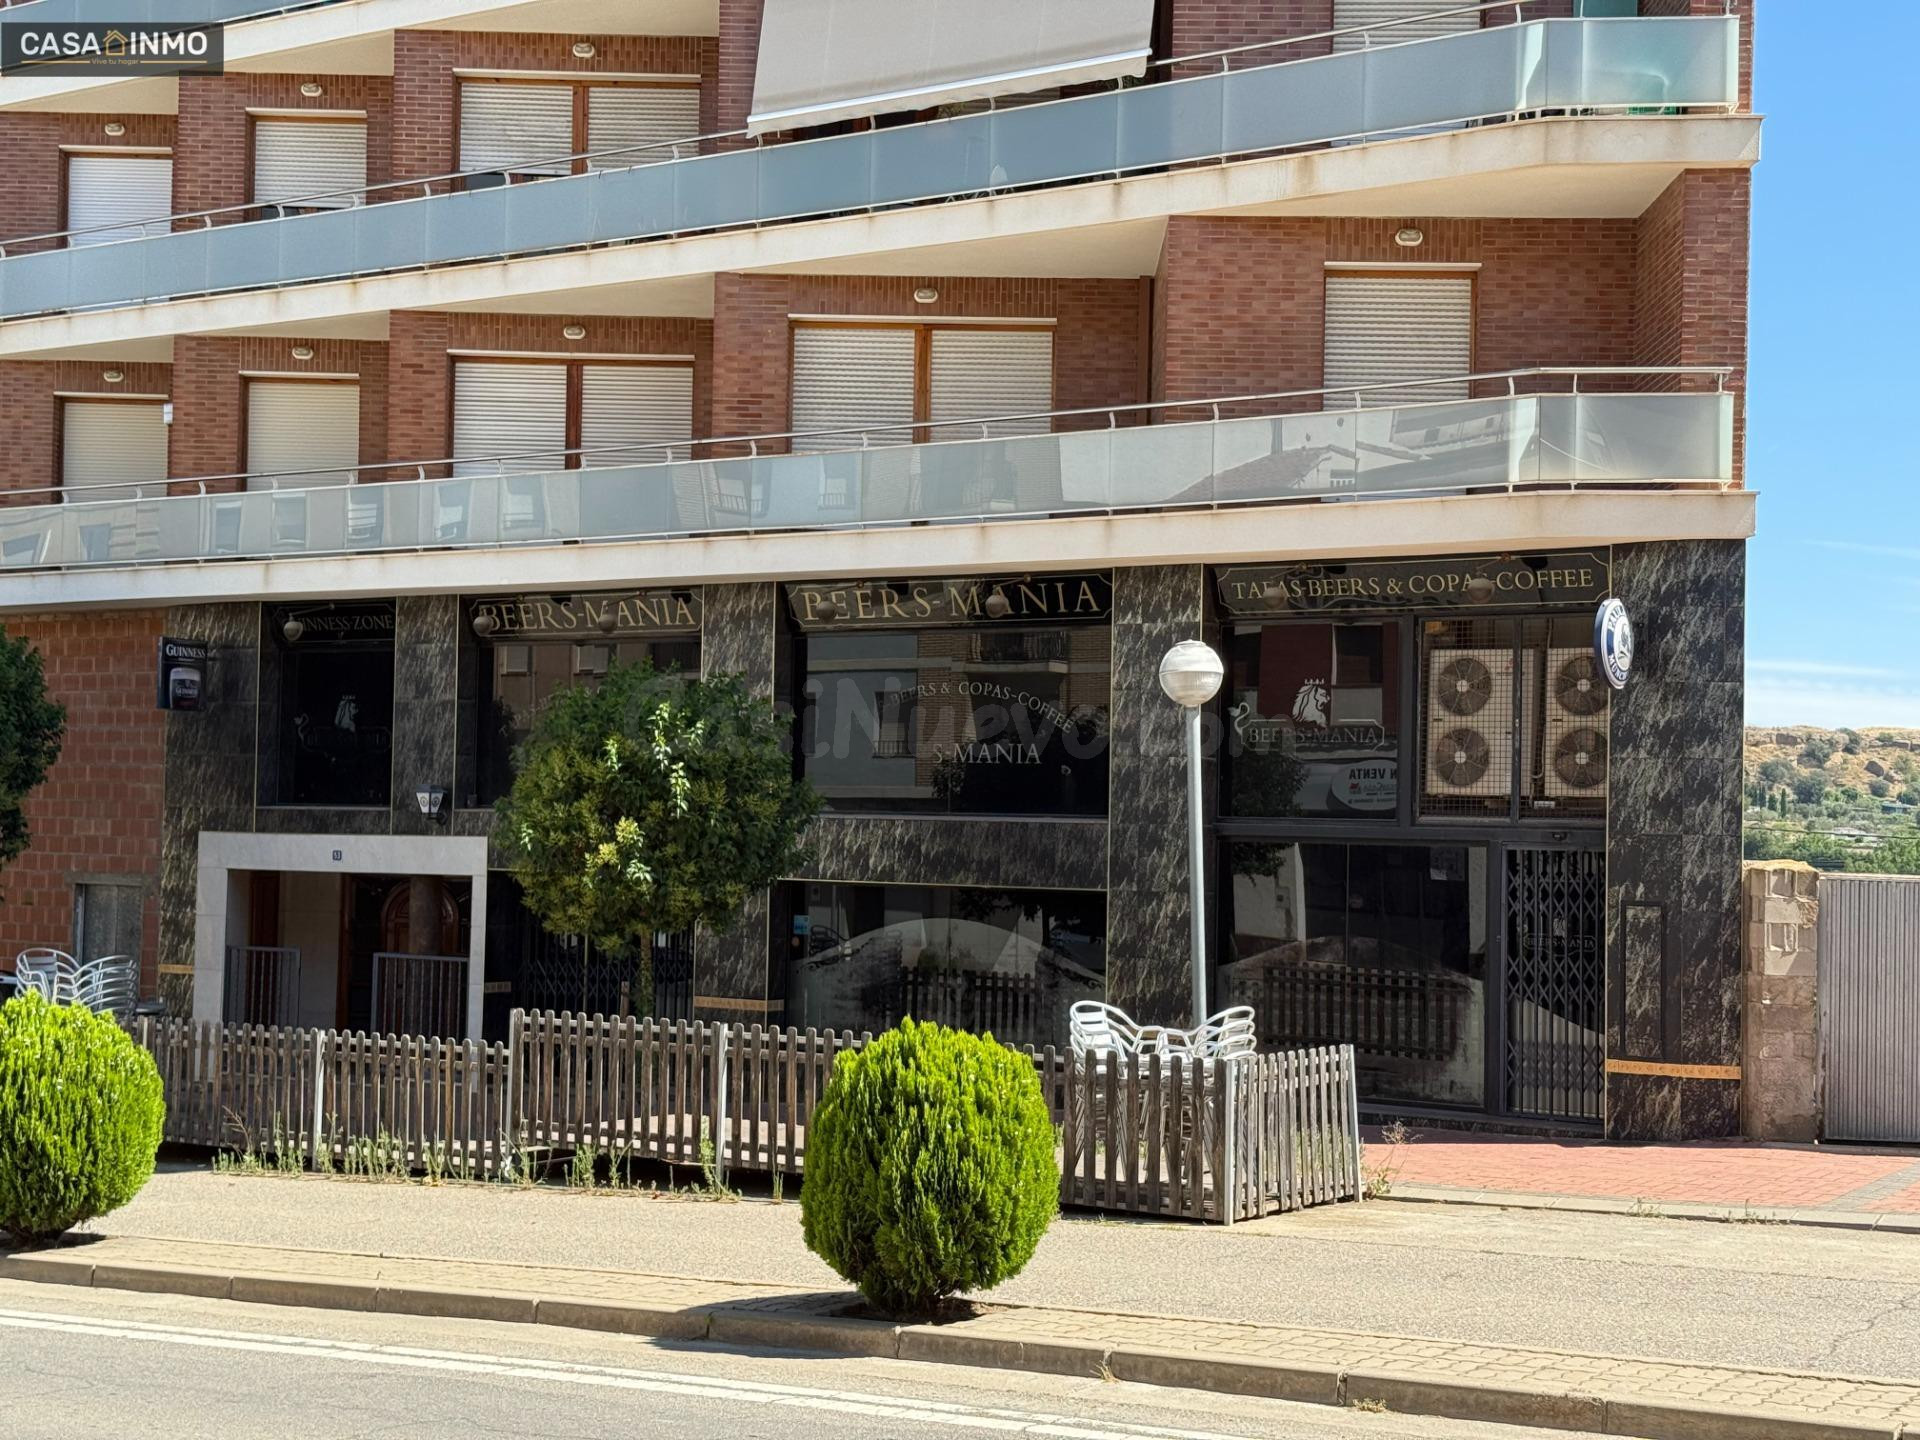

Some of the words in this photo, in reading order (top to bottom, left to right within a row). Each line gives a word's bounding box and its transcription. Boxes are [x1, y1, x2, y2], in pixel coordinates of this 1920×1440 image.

[1386, 577, 1404, 596] &
[1408, 568, 1595, 595] COPA-COFFEE
[165, 644, 207, 658] GUINNESS
[939, 681, 951, 695] &
[957, 680, 1076, 735] COPAS-COFFEE
